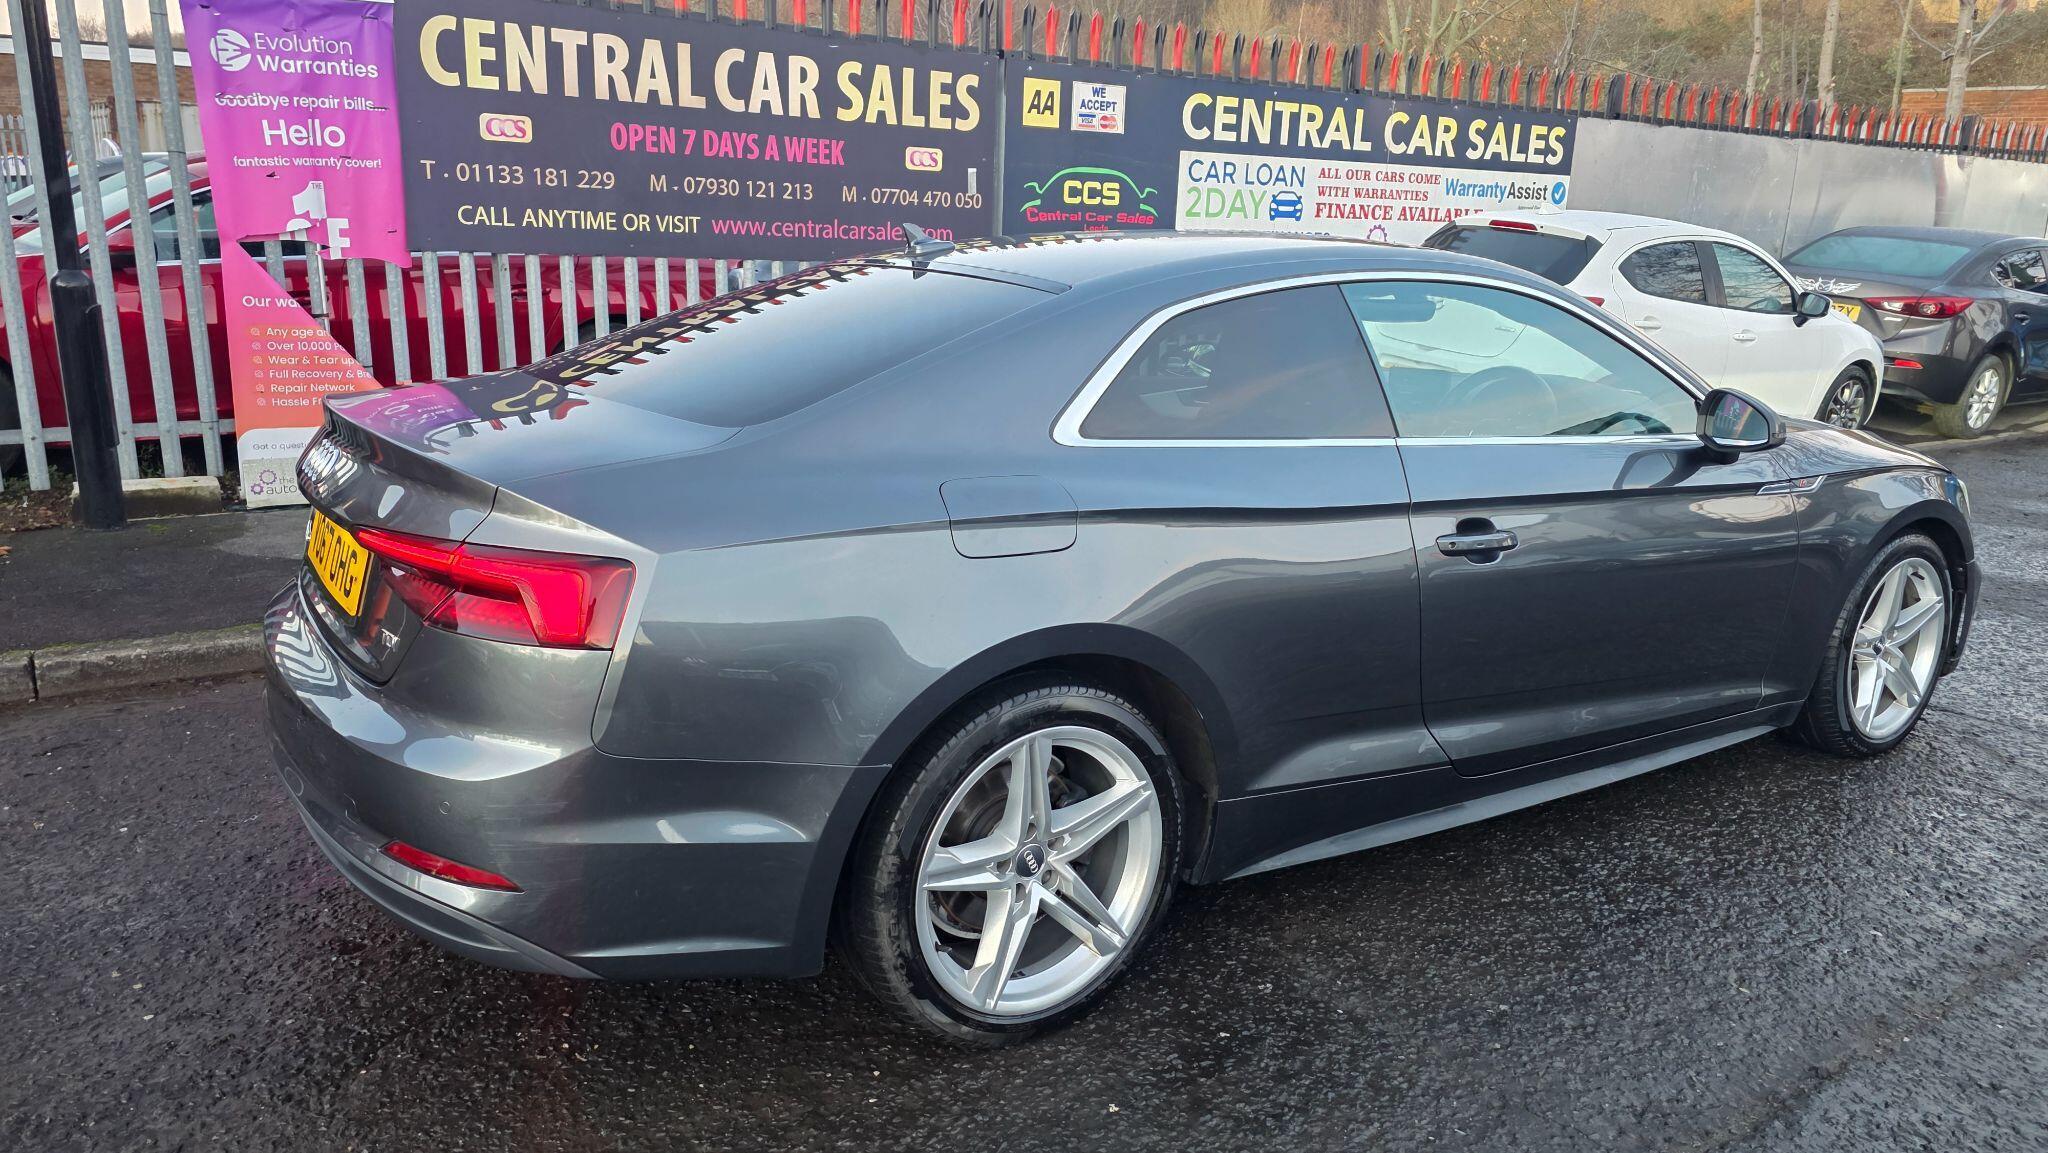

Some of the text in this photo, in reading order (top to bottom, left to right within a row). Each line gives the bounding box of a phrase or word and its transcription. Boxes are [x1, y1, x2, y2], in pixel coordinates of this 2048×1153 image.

[254, 32, 352, 55] Evolution
[256, 54, 379, 78] Warranties
[419, 14, 980, 132] CENTRAL CAR SALES
[1091, 86, 1107, 98] WE
[215, 92, 289, 111] Goodbye
[293, 93, 340, 112] repair
[1027, 89, 1055, 116] AA
[1079, 98, 1117, 112] ACCEPT
[261, 118, 346, 148] Hello
[1182, 92, 1566, 166] CENTRAL CAR SALES
[610, 122, 845, 166] OPEN 7 DAYS A WEEK
[233, 155, 383, 170] fantastic warranty cover!
[456, 162, 524, 185] 01133
[533, 167, 568, 188] 181
[576, 169, 616, 191] 229
[1188, 158, 1306, 188] CAR LOAN
[1318, 167, 1441, 186] ALL OUR CARS COME
[311, 182, 323, 190] THE
[684, 175, 740, 197] 07930
[746, 179, 775, 199] 121
[782, 182, 813, 201] 213
[1063, 180, 1120, 206] CCS
[1317, 185, 1429, 202] WITH WARRANTIES
[871, 187, 919, 207] 07704
[923, 190, 951, 208] 470
[955, 193, 982, 209] 050
[1185, 186, 1268, 220] 2DAY
[457, 204, 516, 228] CALL
[522, 208, 617, 231] ANYTIME
[622, 213, 650, 232] OR
[656, 215, 700, 234] VISIT
[1026, 207, 1154, 225] Central Car Sales
[1314, 202, 1393, 221] FINANCE
[242, 295, 271, 307] Our
[266, 327, 288, 339] Any
[292, 328, 314, 339] age
[267, 341, 294, 351] Over
[297, 341, 332, 352] 10,000
[268, 355, 354, 367] Wear & Tear up
[269, 370, 289, 379] Full
[291, 370, 343, 380] Recovery
[345, 370, 355, 379] &
[271, 383, 356, 395] Repair Network
[272, 397, 309, 407] Hassle
[279, 476, 295, 485] the
